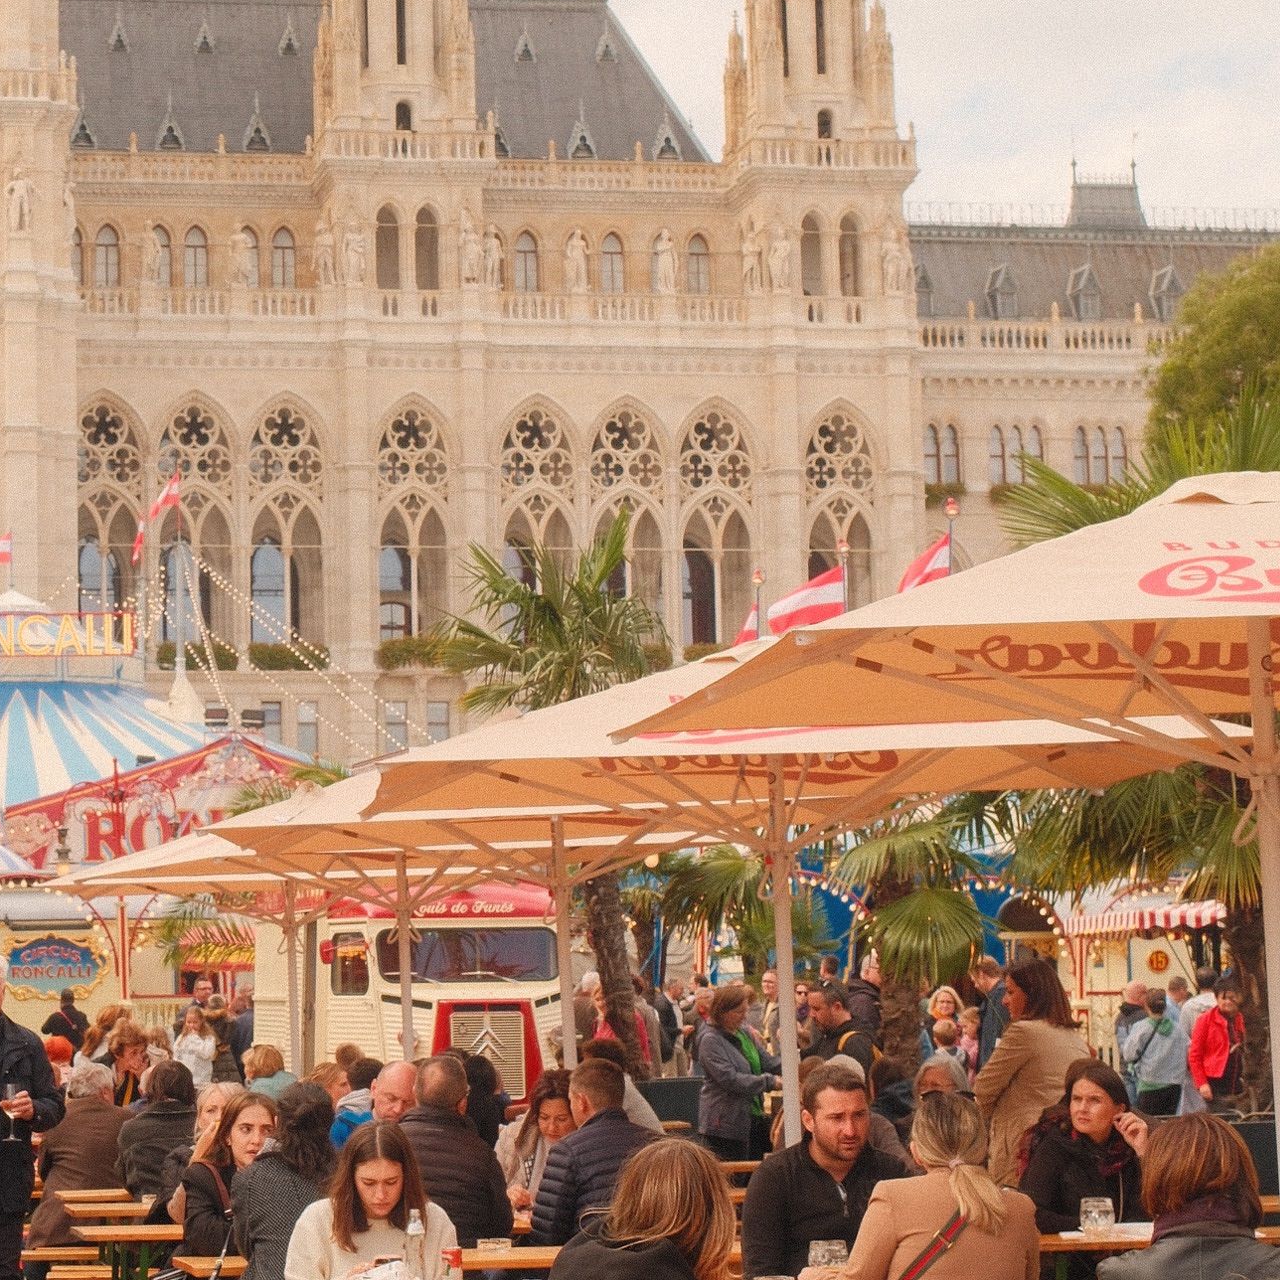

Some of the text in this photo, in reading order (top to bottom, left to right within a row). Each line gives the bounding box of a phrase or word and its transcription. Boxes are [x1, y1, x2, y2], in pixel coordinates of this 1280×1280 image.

[413, 900, 448, 917] ouis
[450, 901, 469, 914] de
[21, 945, 81, 963] CIRCUS
[11, 964, 93, 979] RONCALLI
